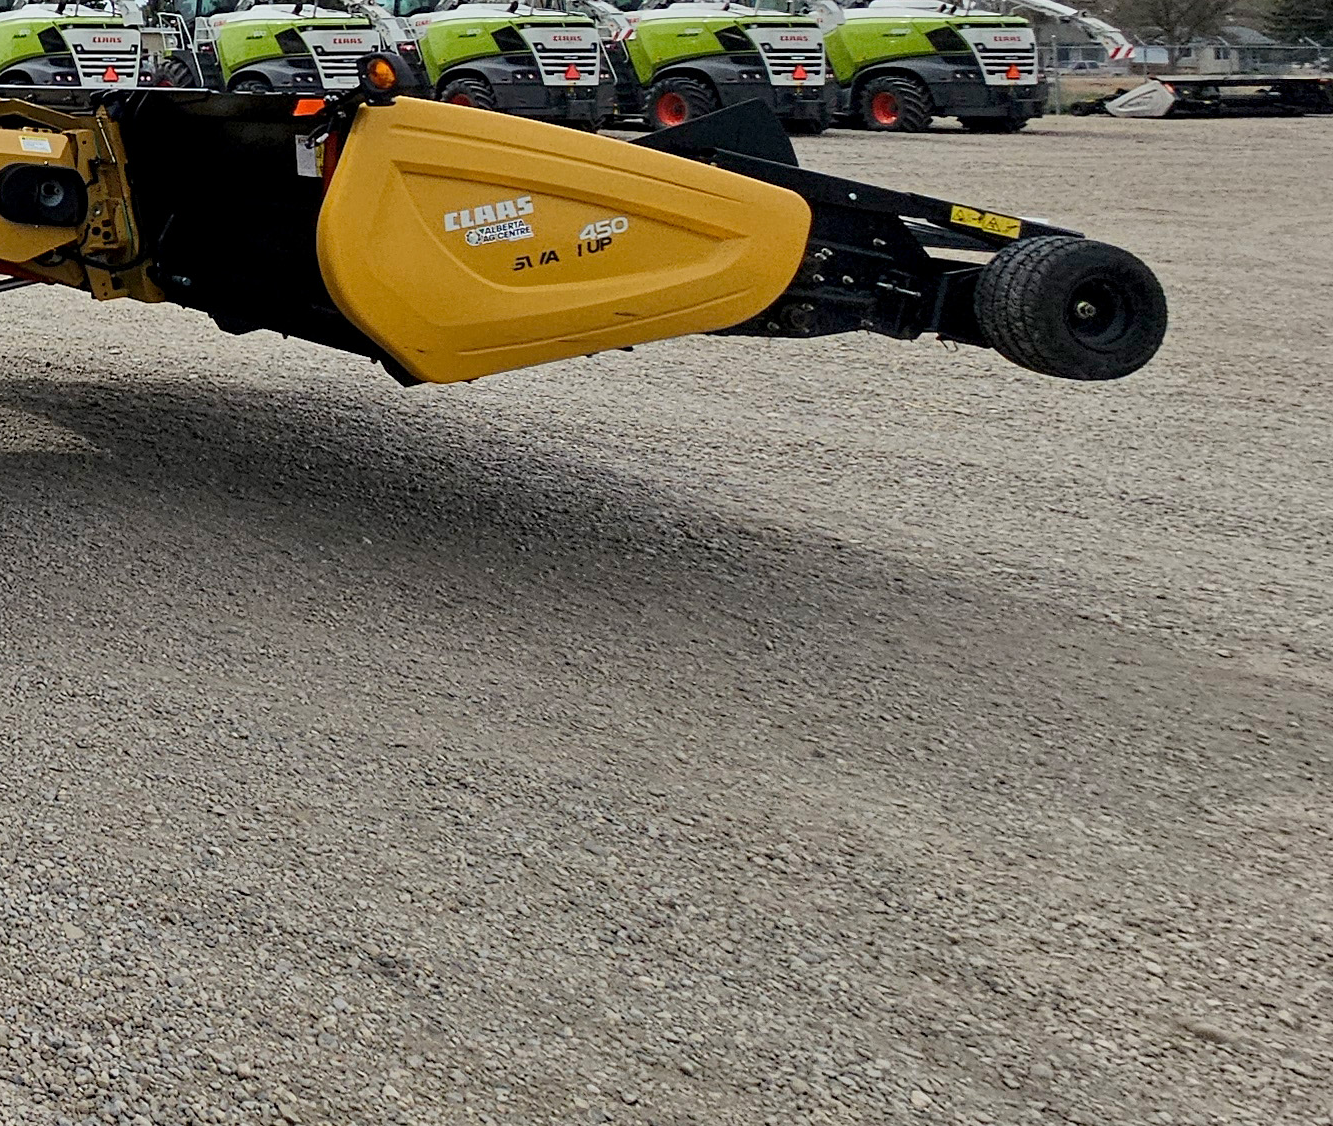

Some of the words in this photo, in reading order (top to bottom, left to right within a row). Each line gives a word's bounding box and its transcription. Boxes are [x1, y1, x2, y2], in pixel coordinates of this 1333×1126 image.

[444, 196, 533, 231] CLAAS
[483, 234, 496, 242] AG
[497, 227, 531, 240] CENTRE
[485, 220, 525, 235] ALBERTA
[579, 216, 629, 240] 450
